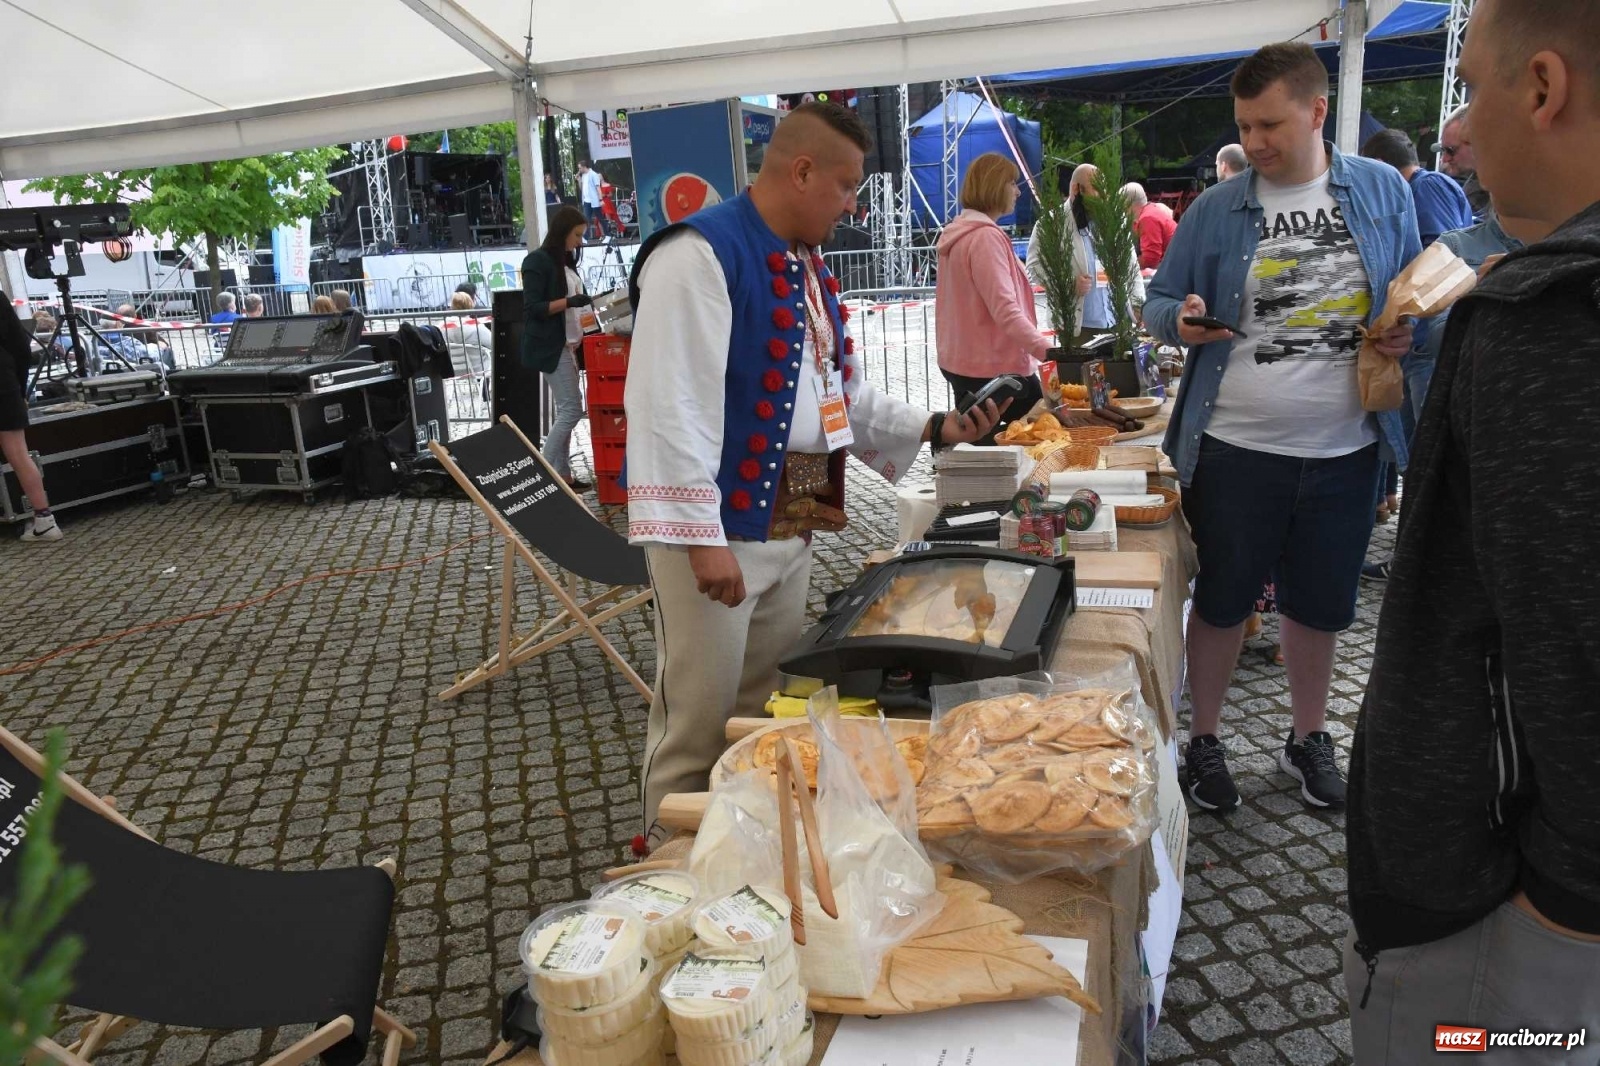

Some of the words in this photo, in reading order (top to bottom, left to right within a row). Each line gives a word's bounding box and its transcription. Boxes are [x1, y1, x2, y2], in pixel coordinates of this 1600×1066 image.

[753, 122, 770, 137] pepsi
[513, 456, 534, 470] Group
[524, 495, 538, 506] 531
[535, 489, 548, 500] 557
[0, 814, 29, 846] 557
